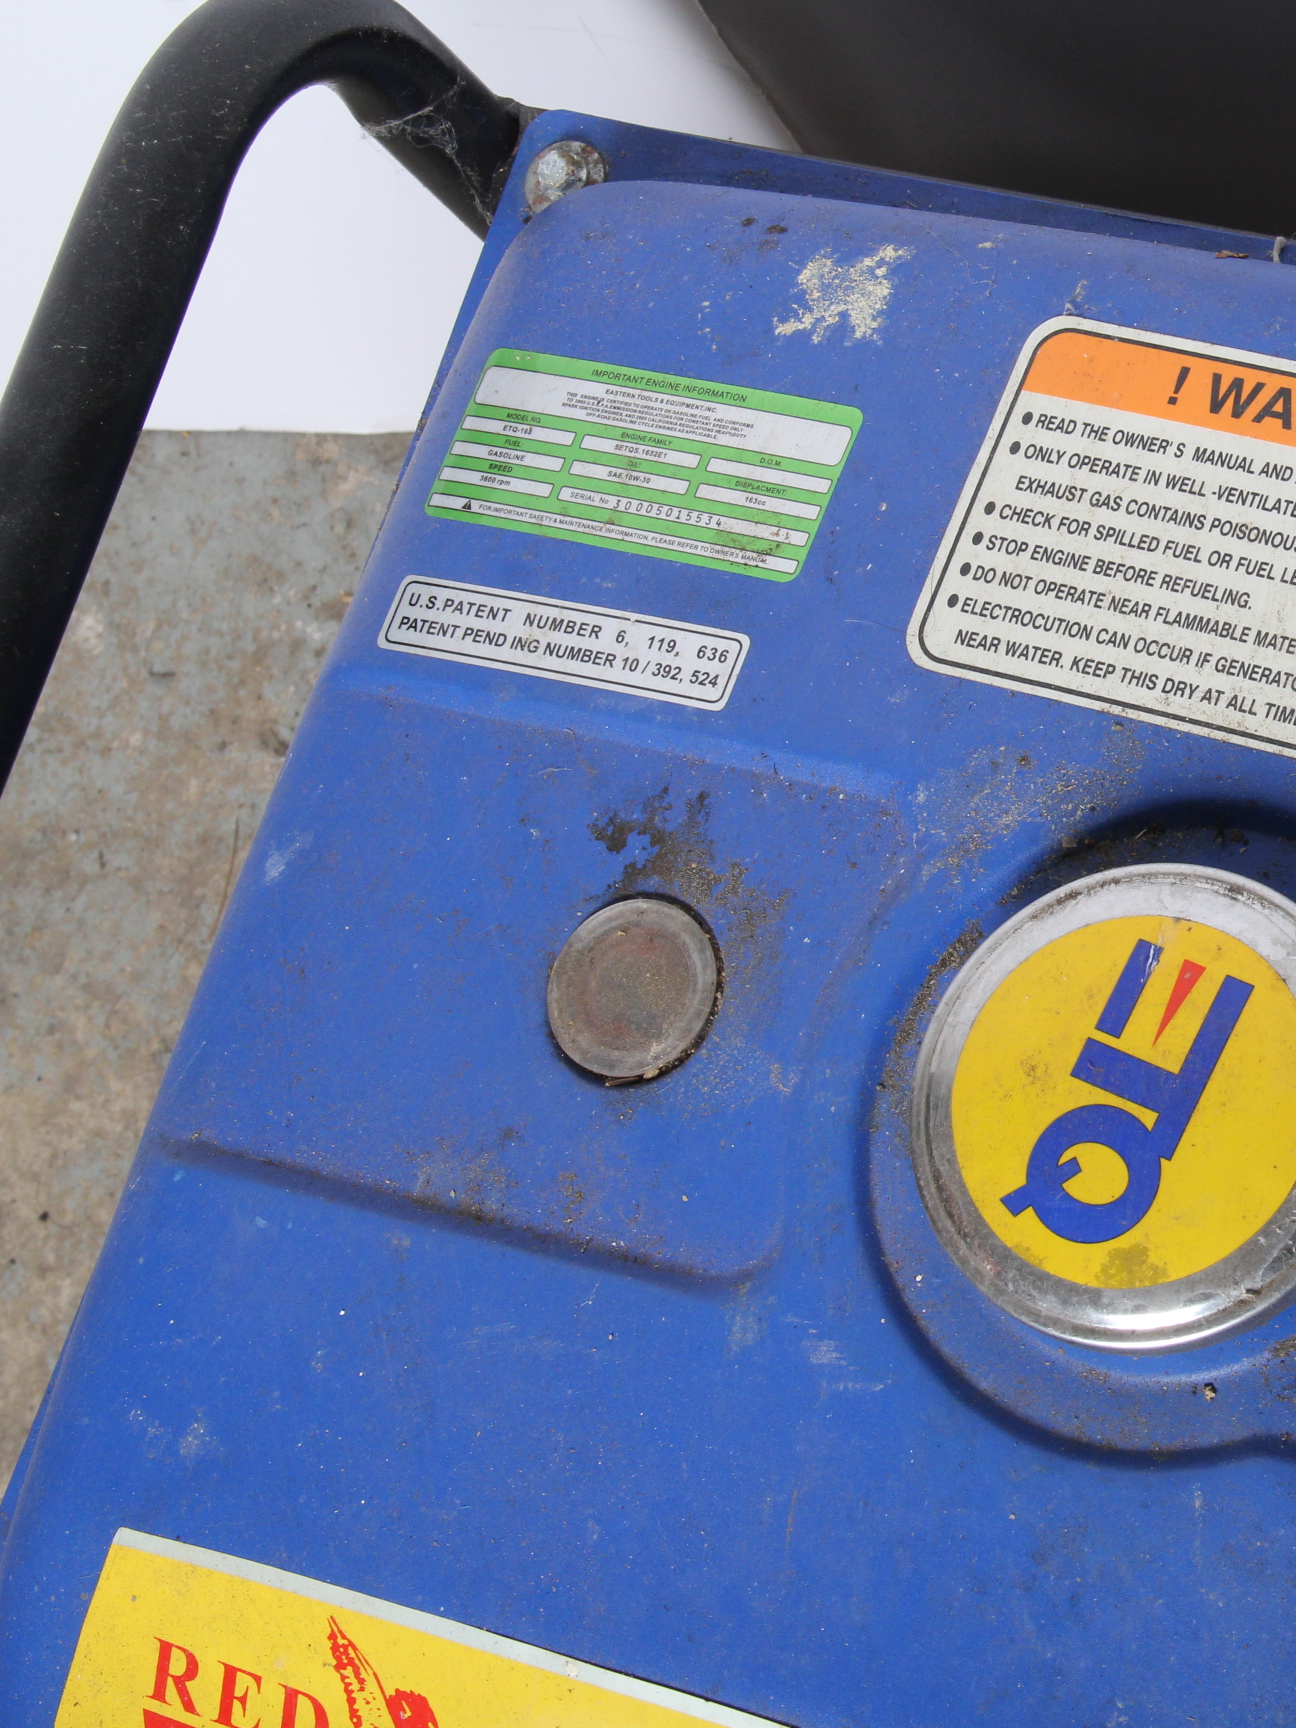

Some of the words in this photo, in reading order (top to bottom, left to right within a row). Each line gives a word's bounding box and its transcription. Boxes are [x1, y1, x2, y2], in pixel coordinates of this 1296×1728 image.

[590, 368, 645, 384] IMPORTANT
[644, 377, 681, 391] ENGINE
[681, 384, 747, 402] INFORMATION
[604, 388, 635, 398] EASTERN
[636, 393, 658, 403] TOOLS
[505, 411, 528, 421] MODEL
[620, 431, 647, 442] ENGINE
[647, 435, 673, 446] FAMILY
[487, 449, 525, 461] GASOLINE
[1023, 443, 1066, 464] ONLY
[1067, 452, 1141, 481] OPERATE
[1142, 468, 1162, 486] IN
[1165, 473, 1205, 497] WELL
[1034, 413, 1077, 434] READ
[1080, 421, 1110, 442] THE
[1191, 446, 1254, 474] MANUAL
[1258, 461, 1293, 481] AND
[569, 491, 595, 502] SERIAL
[598, 496, 609, 504] No
[606, 470, 623, 478] SAE
[624, 472, 651, 483] 10W-30
[744, 495, 766, 506] 163cc
[1015, 474, 1087, 502] EXHAUST
[1088, 490, 1122, 511] GAS
[1125, 498, 1206, 530] CONTAINS
[491, 506, 528, 517] IMPORTANT
[527, 512, 552, 522] SAFETY
[558, 518, 603, 532] MAINTENANCE
[650, 535, 675, 546] PLEASE
[676, 540, 699, 550] REFER
[998, 503, 1055, 529] CHECK
[1056, 515, 1091, 537] FOR
[1093, 524, 1160, 552] SPILLED
[1162, 539, 1201, 563] FUEL
[1207, 549, 1233, 569] OR
[1234, 556, 1275, 580] FUEL
[985, 534, 1028, 556] STOP
[1030, 544, 1091, 571] ENGINE
[1092, 558, 1158, 586] BEFORE
[1159, 573, 1250, 609] REFUELING.
[971, 564, 996, 584] DO
[998, 570, 1033, 591] NOT
[1034, 578, 1106, 608] OPERATE
[1107, 595, 1152, 619] NEAR
[1154, 606, 1251, 643] FLAMMABLE
[397, 615, 460, 638] PATENT
[543, 641, 616, 667] NUMBER
[689, 669, 719, 687] 524
[523, 612, 602, 639] NUMBER
[615, 629, 628, 647] 6,
[647, 635, 679, 657] 119,
[696, 644, 729, 663] 636
[960, 597, 1093, 640] ELECTROCUTION
[1095, 627, 1131, 649] CAN
[1133, 636, 1193, 664] OCCUR
[1194, 651, 1213, 668] IF
[954, 628, 1001, 653] NEAR
[1004, 639, 1063, 668] WATER.
[1069, 655, 1116, 678] KEEP
[1120, 666, 1158, 690] THIS
[1160, 677, 1199, 699] DRY
[1199, 687, 1225, 706] AT
[1225, 693, 1257, 716] ALL
[145, 1636, 330, 1728] RED
